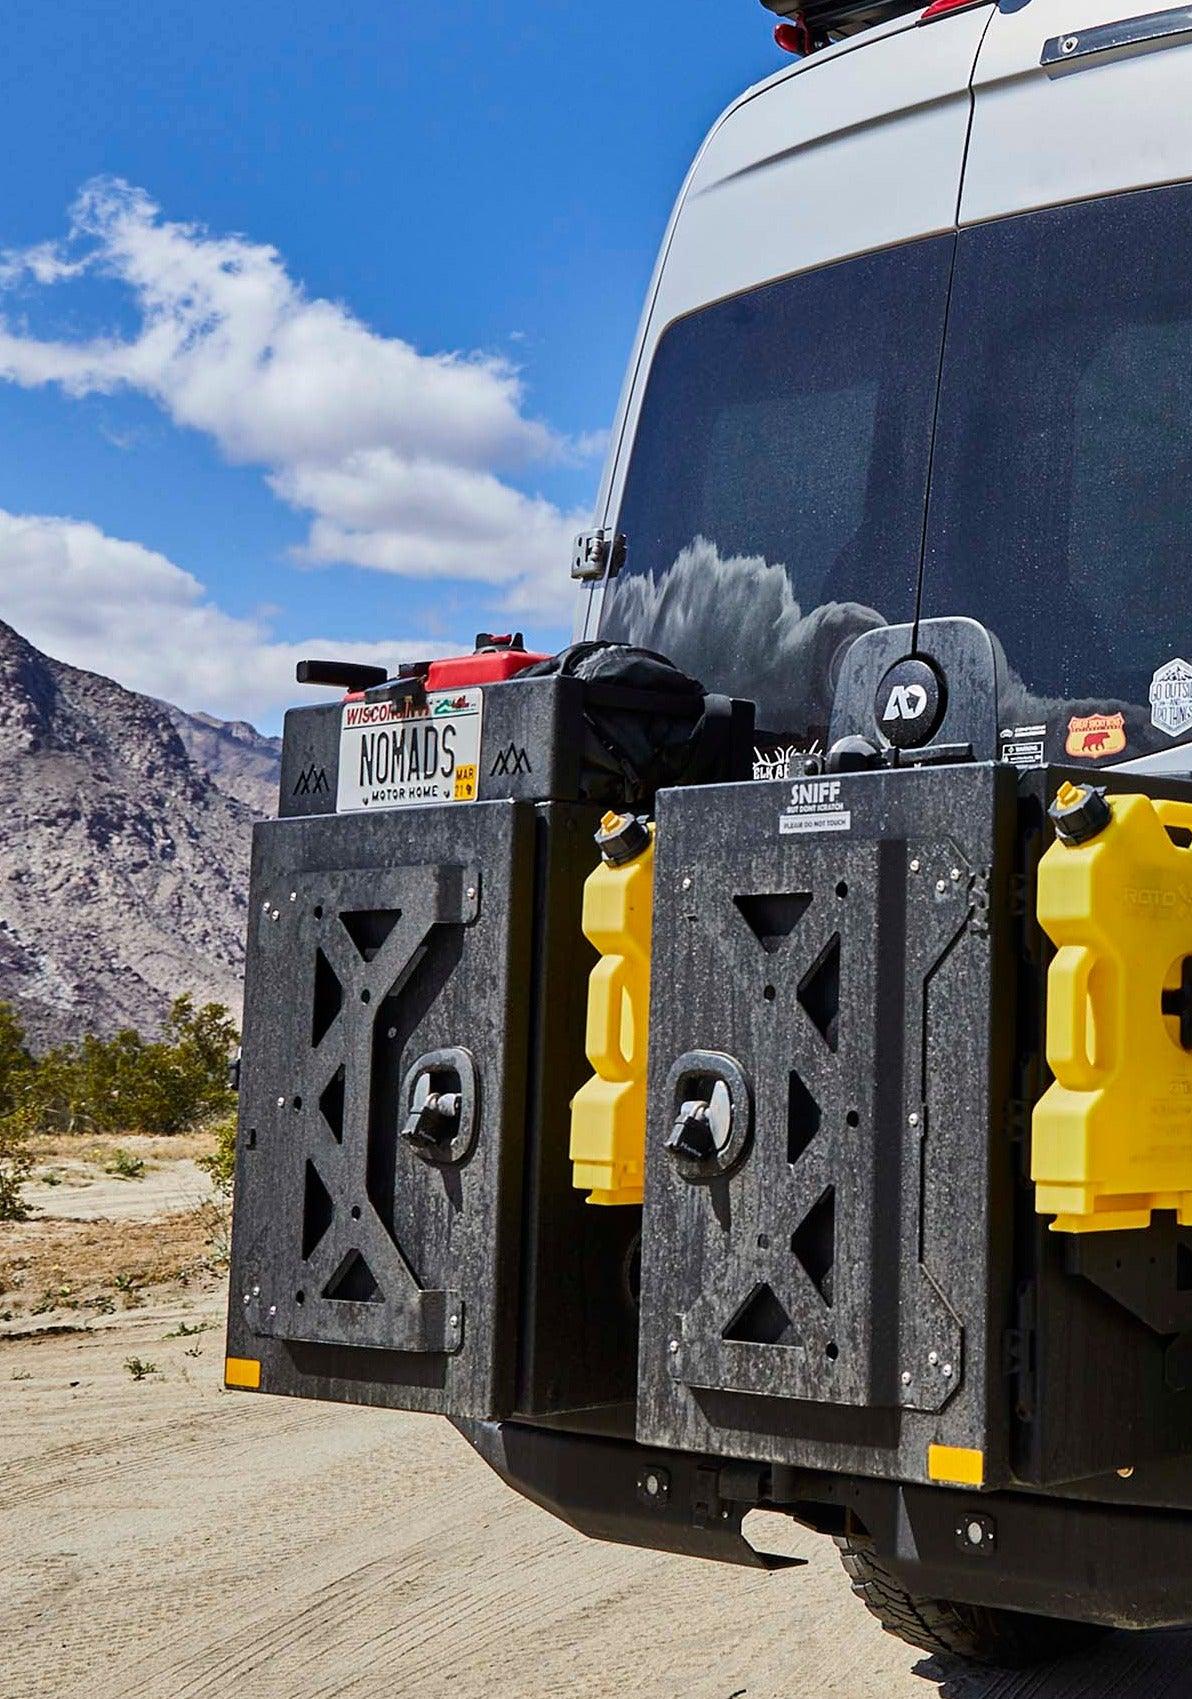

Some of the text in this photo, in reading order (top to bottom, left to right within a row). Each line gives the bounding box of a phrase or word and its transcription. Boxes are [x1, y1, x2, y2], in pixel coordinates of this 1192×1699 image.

[1151, 683, 1162, 702] GO
[1157, 706, 1168, 722] DO
[360, 724, 456, 787] NOMADS
[456, 766, 474, 780] MAR
[372, 784, 439, 802] MOTOR HOME
[791, 781, 841, 805] SNIFF
